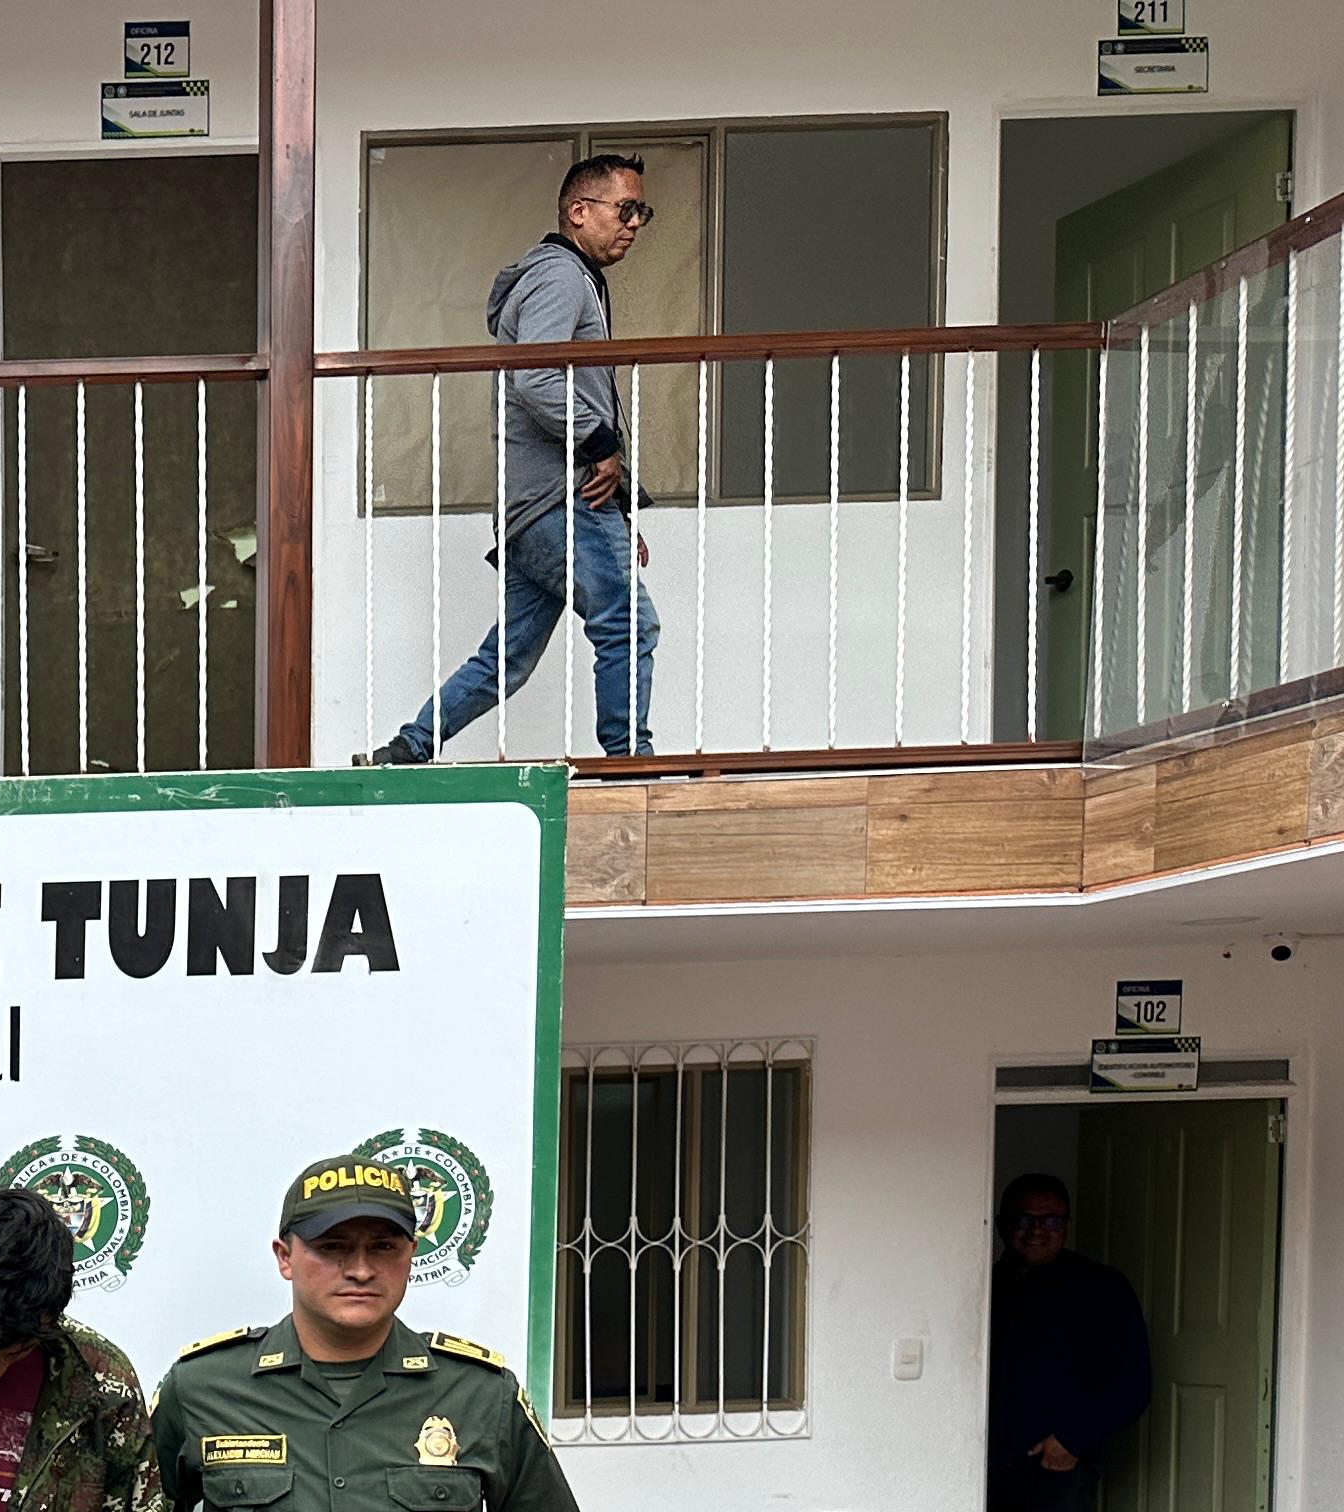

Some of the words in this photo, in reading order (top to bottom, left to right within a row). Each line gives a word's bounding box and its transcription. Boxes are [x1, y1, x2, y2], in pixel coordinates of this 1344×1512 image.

[1134, 1, 1169, 24] 211
[140, 42, 175, 66] 212
[41, 873, 401, 980] TUNJA
[1134, 1001, 1167, 1023] 102
[60, 1153, 78, 1162] DE
[91, 1159, 130, 1222] COLOMBIA
[404, 1146, 422, 1155] DE
[435, 1153, 473, 1216] COLOMBIA
[73, 1235, 124, 1272] ACIONAL
[72, 1269, 109, 1288] ATRIA
